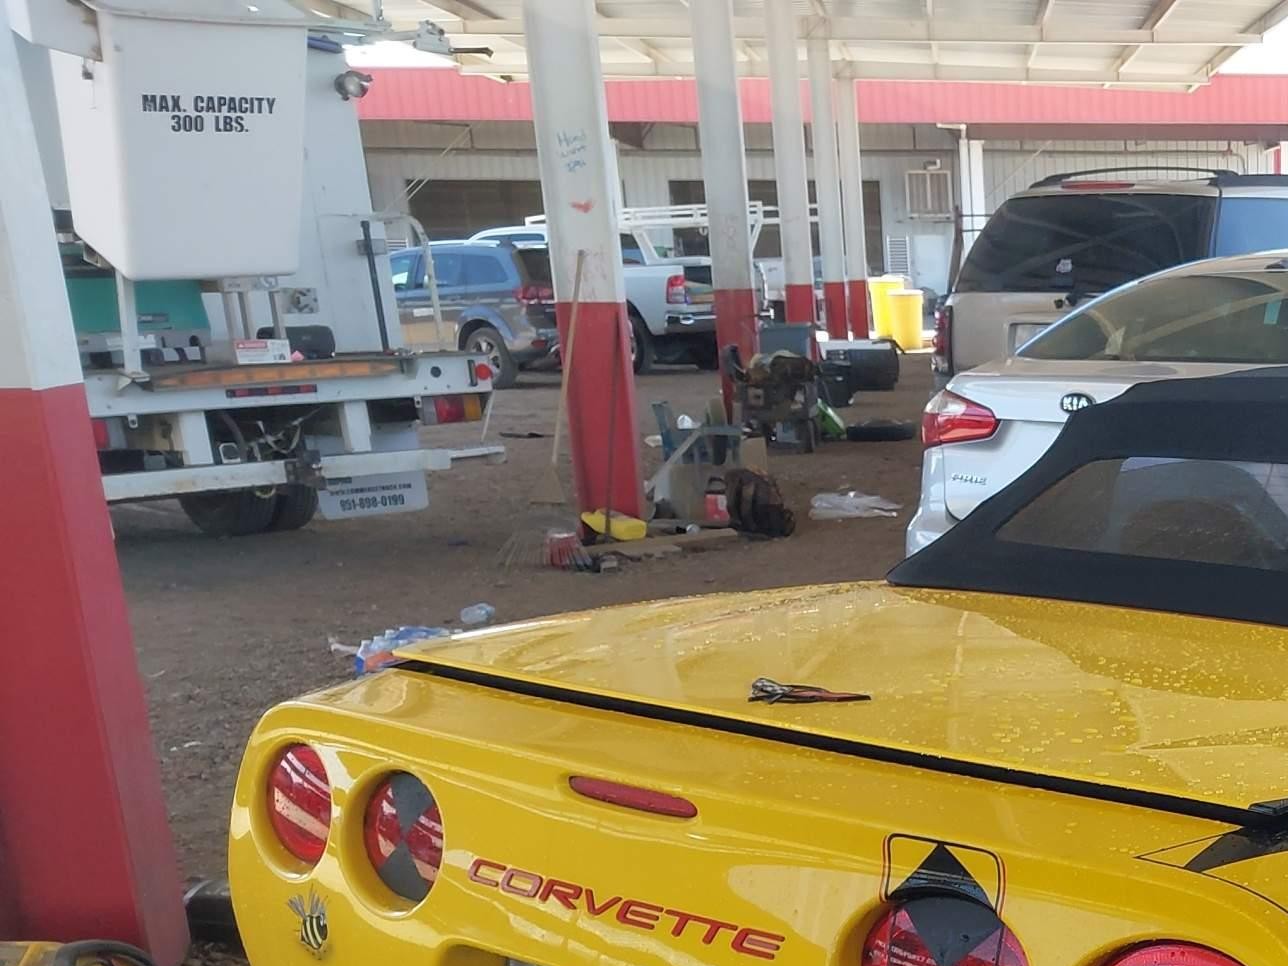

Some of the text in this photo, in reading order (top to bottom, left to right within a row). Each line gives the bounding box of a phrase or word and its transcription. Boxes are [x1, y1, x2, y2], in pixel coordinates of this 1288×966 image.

[141, 94, 276, 114] MAX. CAPACITY
[171, 114, 249, 132] 300 LBS.
[1062, 396, 1089, 411] KIA
[468, 858, 785, 960] CORVETTE
